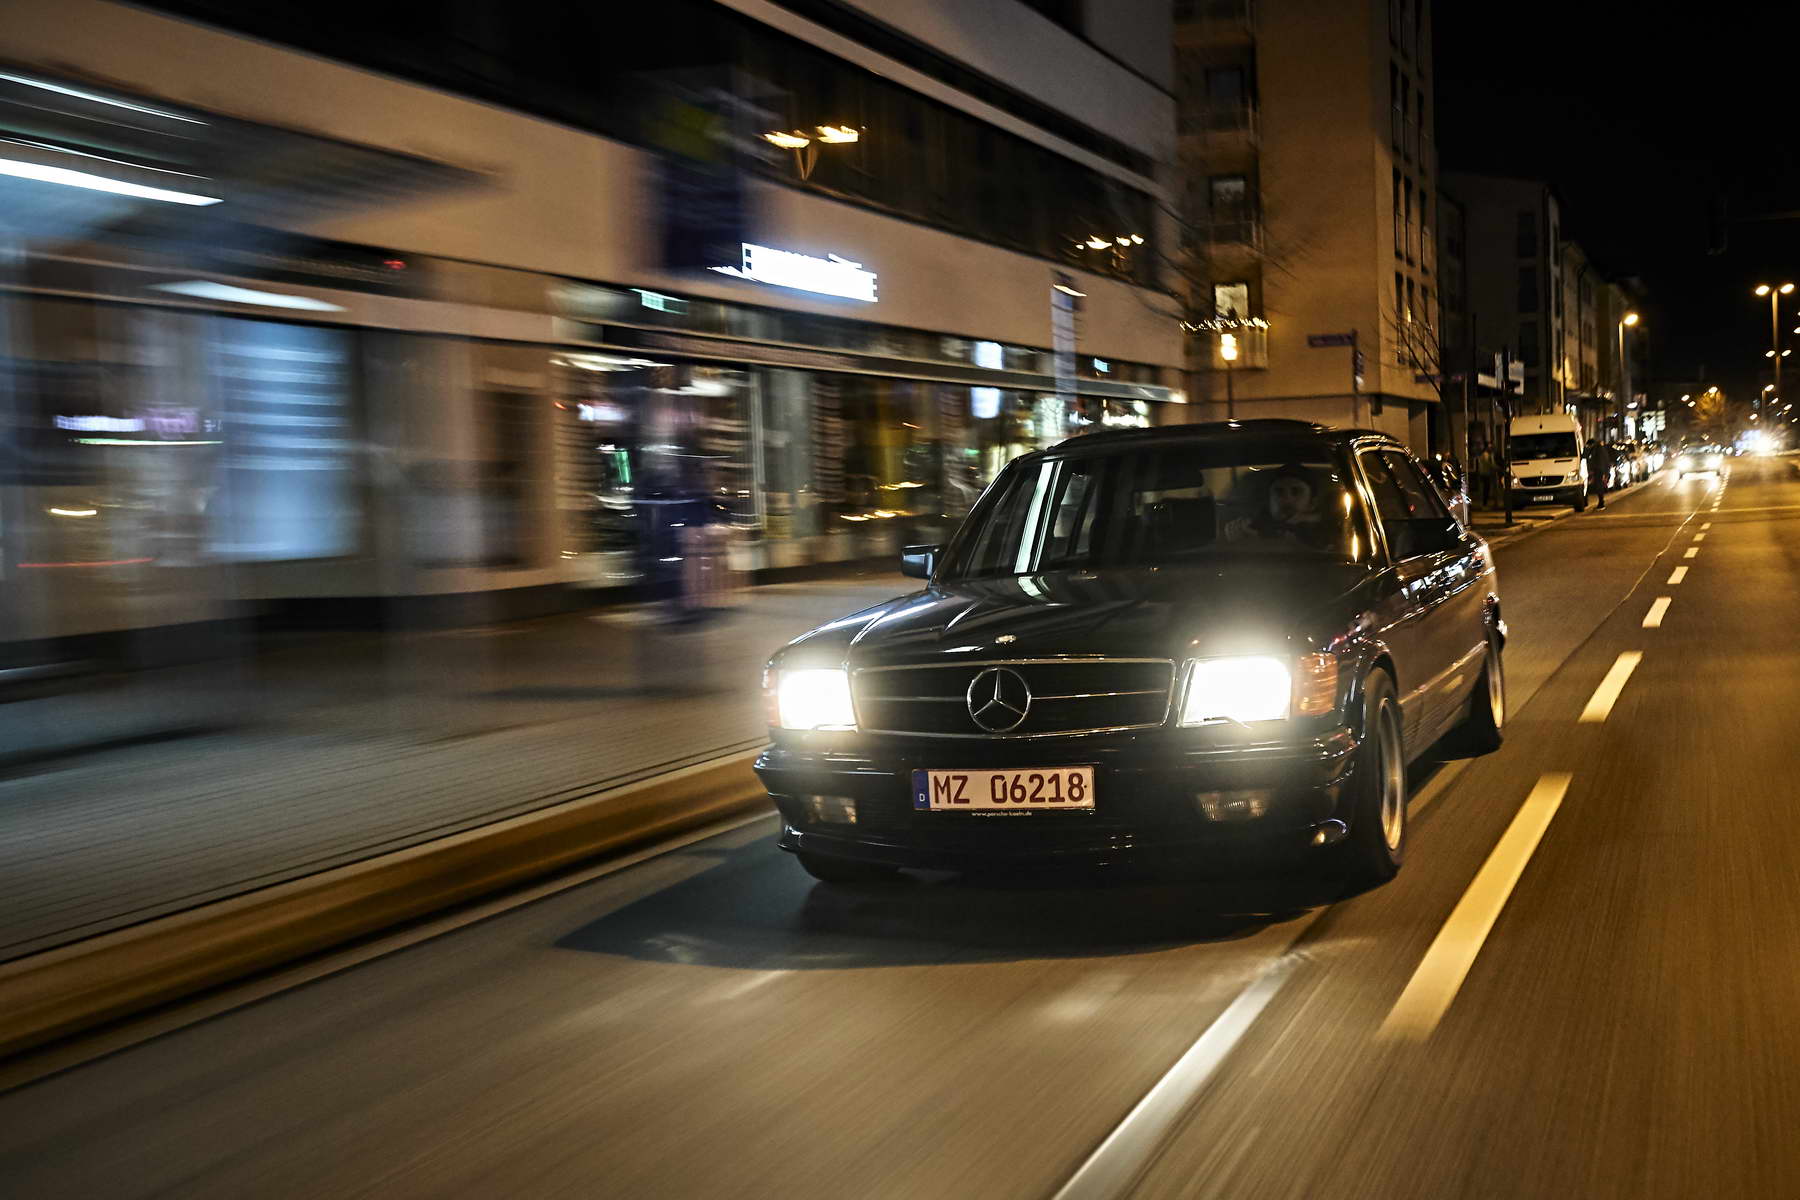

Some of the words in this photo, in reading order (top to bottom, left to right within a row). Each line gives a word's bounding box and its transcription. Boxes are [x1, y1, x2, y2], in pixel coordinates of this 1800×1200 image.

[919, 793, 926, 802] D
[933, 775, 970, 804] MZ
[990, 772, 1085, 804] 06218
